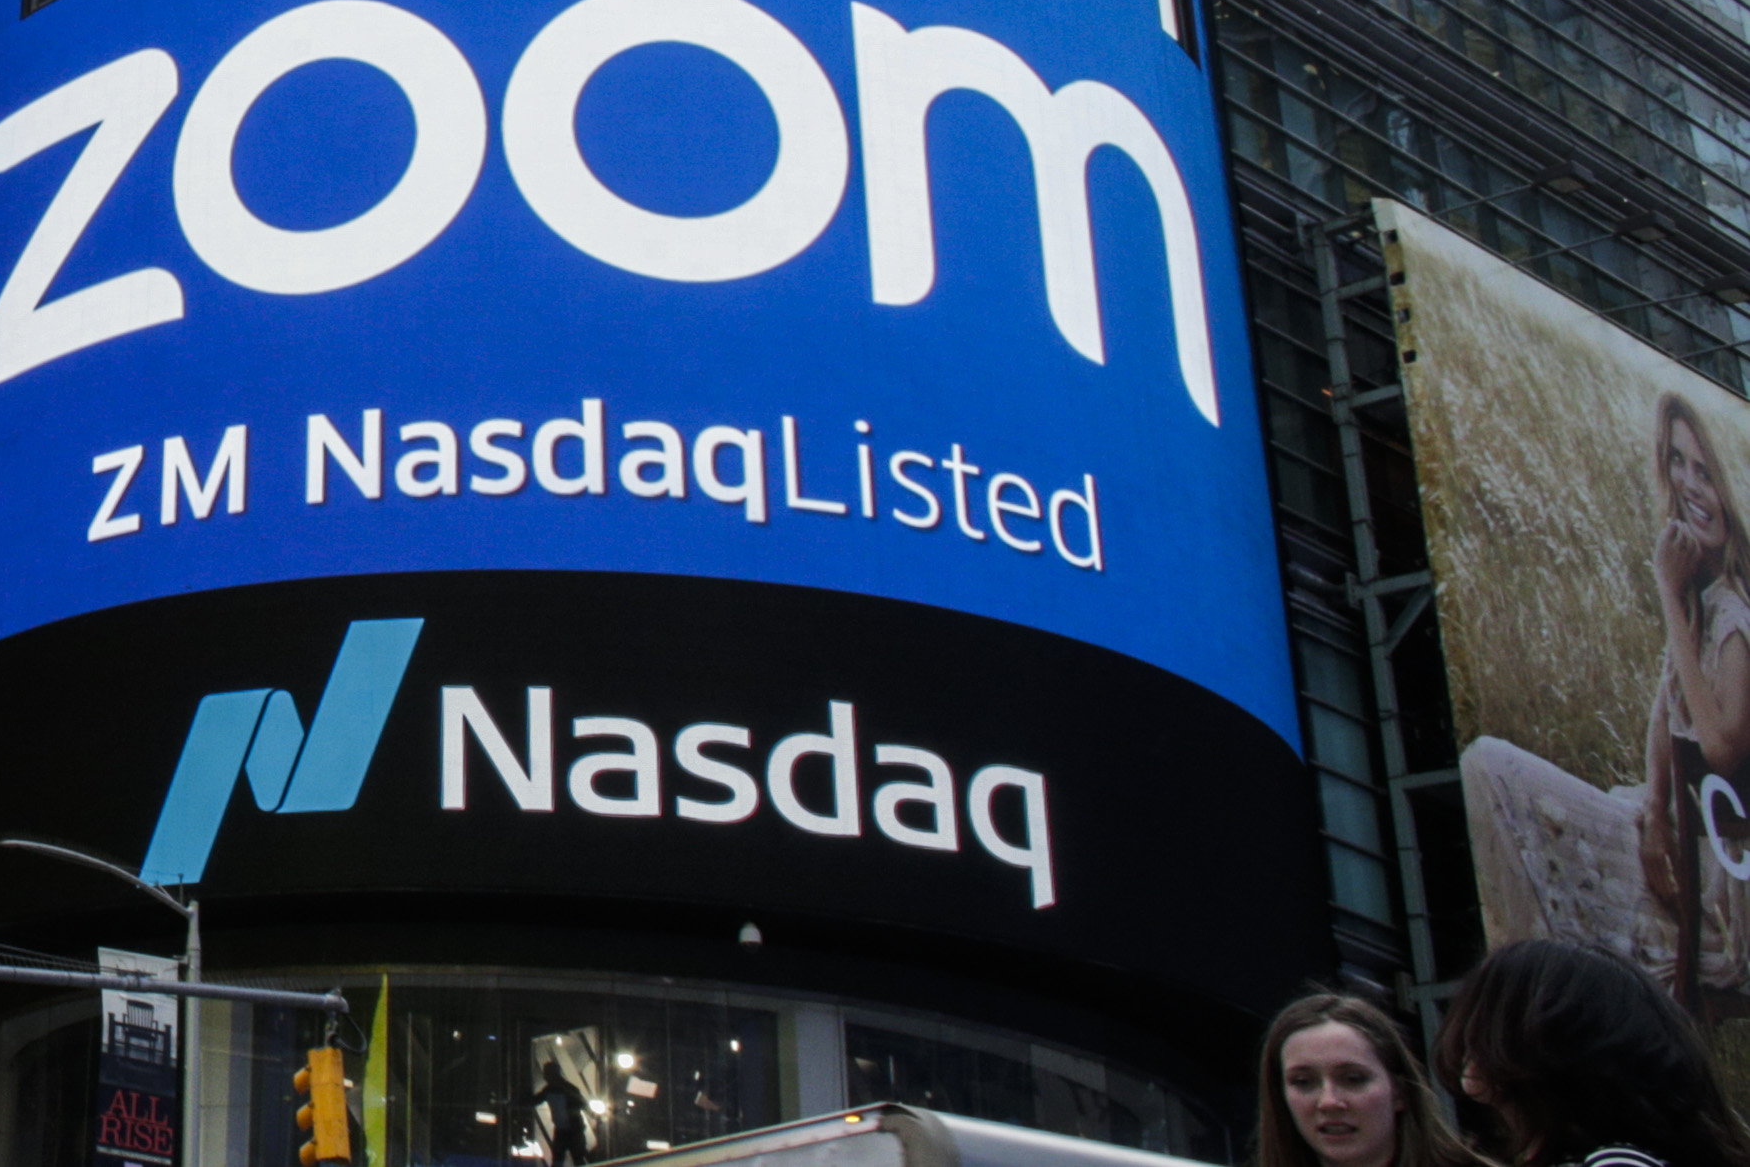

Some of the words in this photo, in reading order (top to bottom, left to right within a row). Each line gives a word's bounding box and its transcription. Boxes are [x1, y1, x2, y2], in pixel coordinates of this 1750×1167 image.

[87, 423, 248, 543] ZM
[441, 686, 1056, 910] Nasdaq
[97, 1113, 174, 1157] RISE
[105, 1089, 170, 1128] ALL
